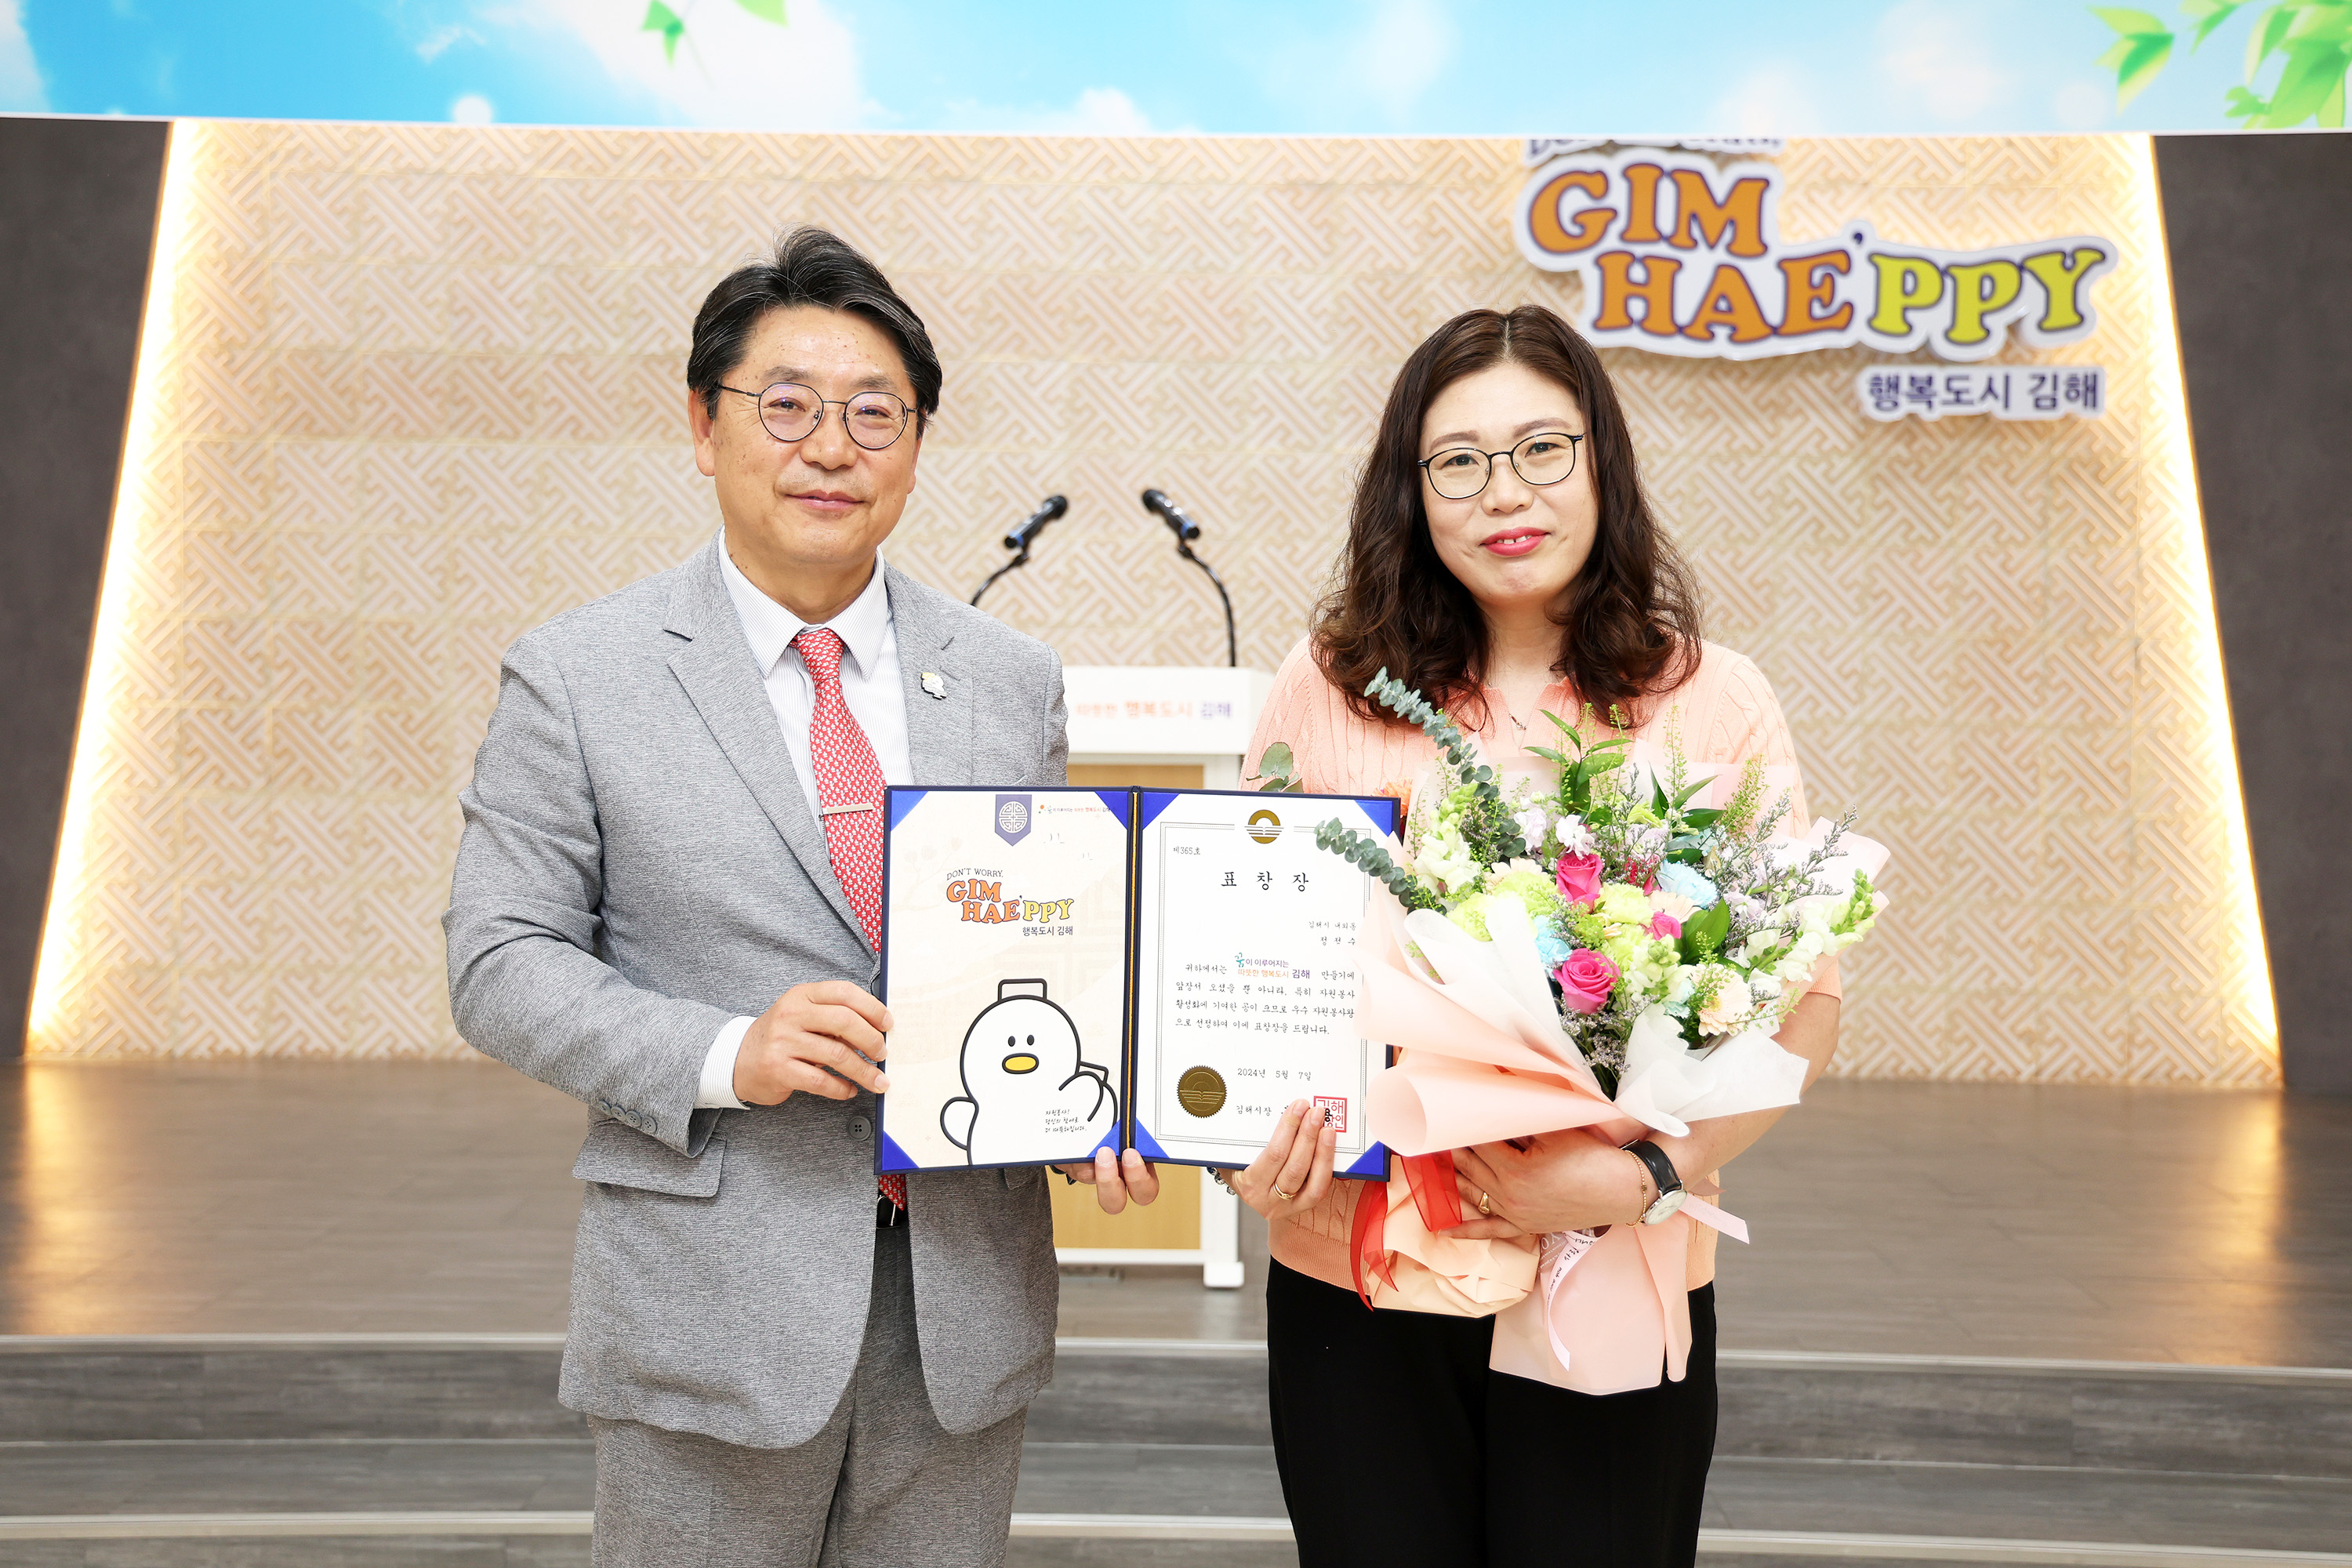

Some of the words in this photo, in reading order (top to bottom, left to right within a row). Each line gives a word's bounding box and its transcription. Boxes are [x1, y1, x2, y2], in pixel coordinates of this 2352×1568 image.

[1528, 161, 1770, 259] GIM
[1592, 232, 2109, 347] HAE'PPY
[1869, 373, 2010, 412] 행복도시
[2029, 373, 2098, 411] 김해
[946, 868, 971, 880] DON'T
[974, 868, 1004, 878] WORRY,
[1221, 871, 1237, 887] 표
[1257, 870, 1273, 891] 창
[1292, 872, 1309, 892] 장
[946, 879, 1001, 902] GIM
[961, 895, 1074, 924] HAE'PPY
[1022, 926, 1054, 937] 행복도시
[1057, 925, 1073, 936] 김해
[1308, 920, 1330, 929] 김해시
[1334, 922, 1356, 931] 내외동
[1254, 959, 1289, 968] 이루어지는
[1185, 964, 1227, 975] 귀하께서는
[1321, 970, 1355, 981] 만들기에
[1261, 970, 1289, 978] 행복도시
[1292, 969, 1310, 979] 김해
[1176, 981, 1201, 992] 앞장서
[1209, 983, 1235, 994] 오셨을
[1242, 985, 1250, 995] 뿐
[1294, 986, 1311, 996] 특히
[1319, 988, 1356, 1000] 자원봉사
[1175, 999, 1207, 1010] 활성화에
[1213, 1001, 1238, 1012] 기여한
[1241, 1002, 1258, 1013] 공이
[1262, 1004, 1287, 1014] 크므로
[1291, 1005, 1308, 1014] 우수
[1313, 1006, 1355, 1018] 자원봉사왕
[1175, 1018, 1192, 1026] 으로
[1196, 1018, 1228, 1029] 선정하여
[1232, 1020, 1249, 1029] 이에
[1254, 1022, 1288, 1033] 표창장을
[1293, 1024, 1330, 1035] 드립니다.
[1237, 1068, 1265, 1078] 2024년
[1276, 1070, 1288, 1080] 5월
[1298, 1071, 1311, 1081] 7일
[1236, 1105, 1272, 1116] 김해시장
